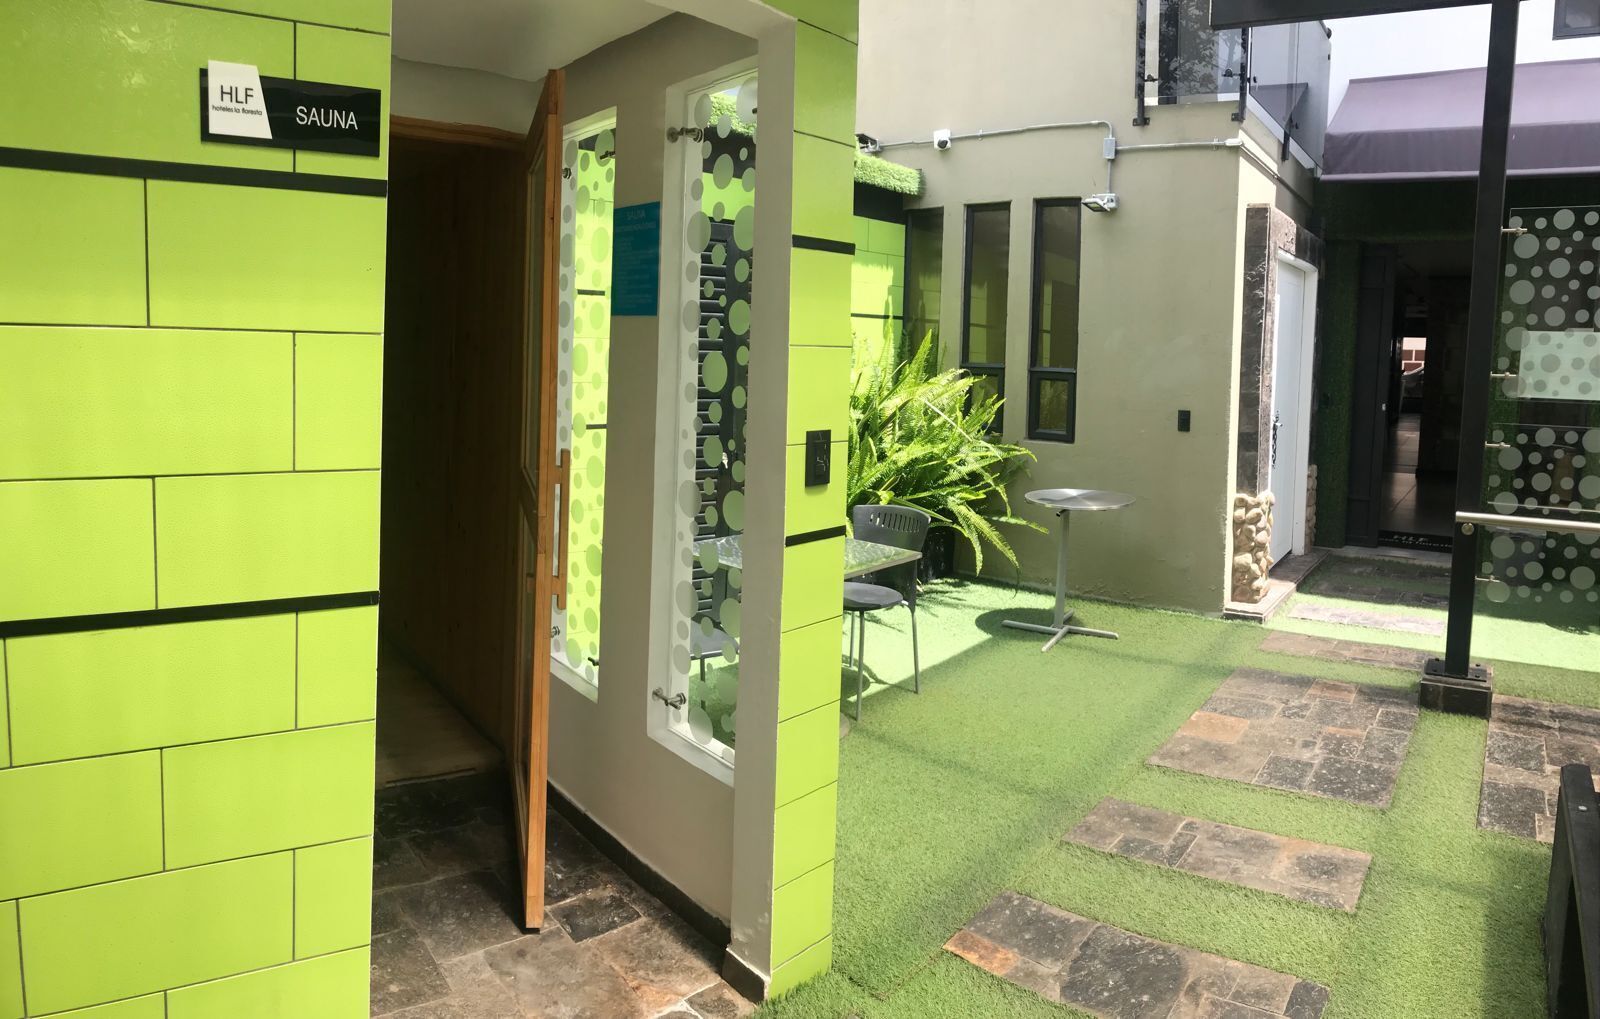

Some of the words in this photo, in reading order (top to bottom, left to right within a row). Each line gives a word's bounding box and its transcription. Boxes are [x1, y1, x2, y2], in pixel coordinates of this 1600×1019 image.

[220, 85, 254, 104] HLF
[211, 104, 233, 112] hoteles
[241, 107, 262, 115] floresta
[296, 106, 358, 130] SAUNA
